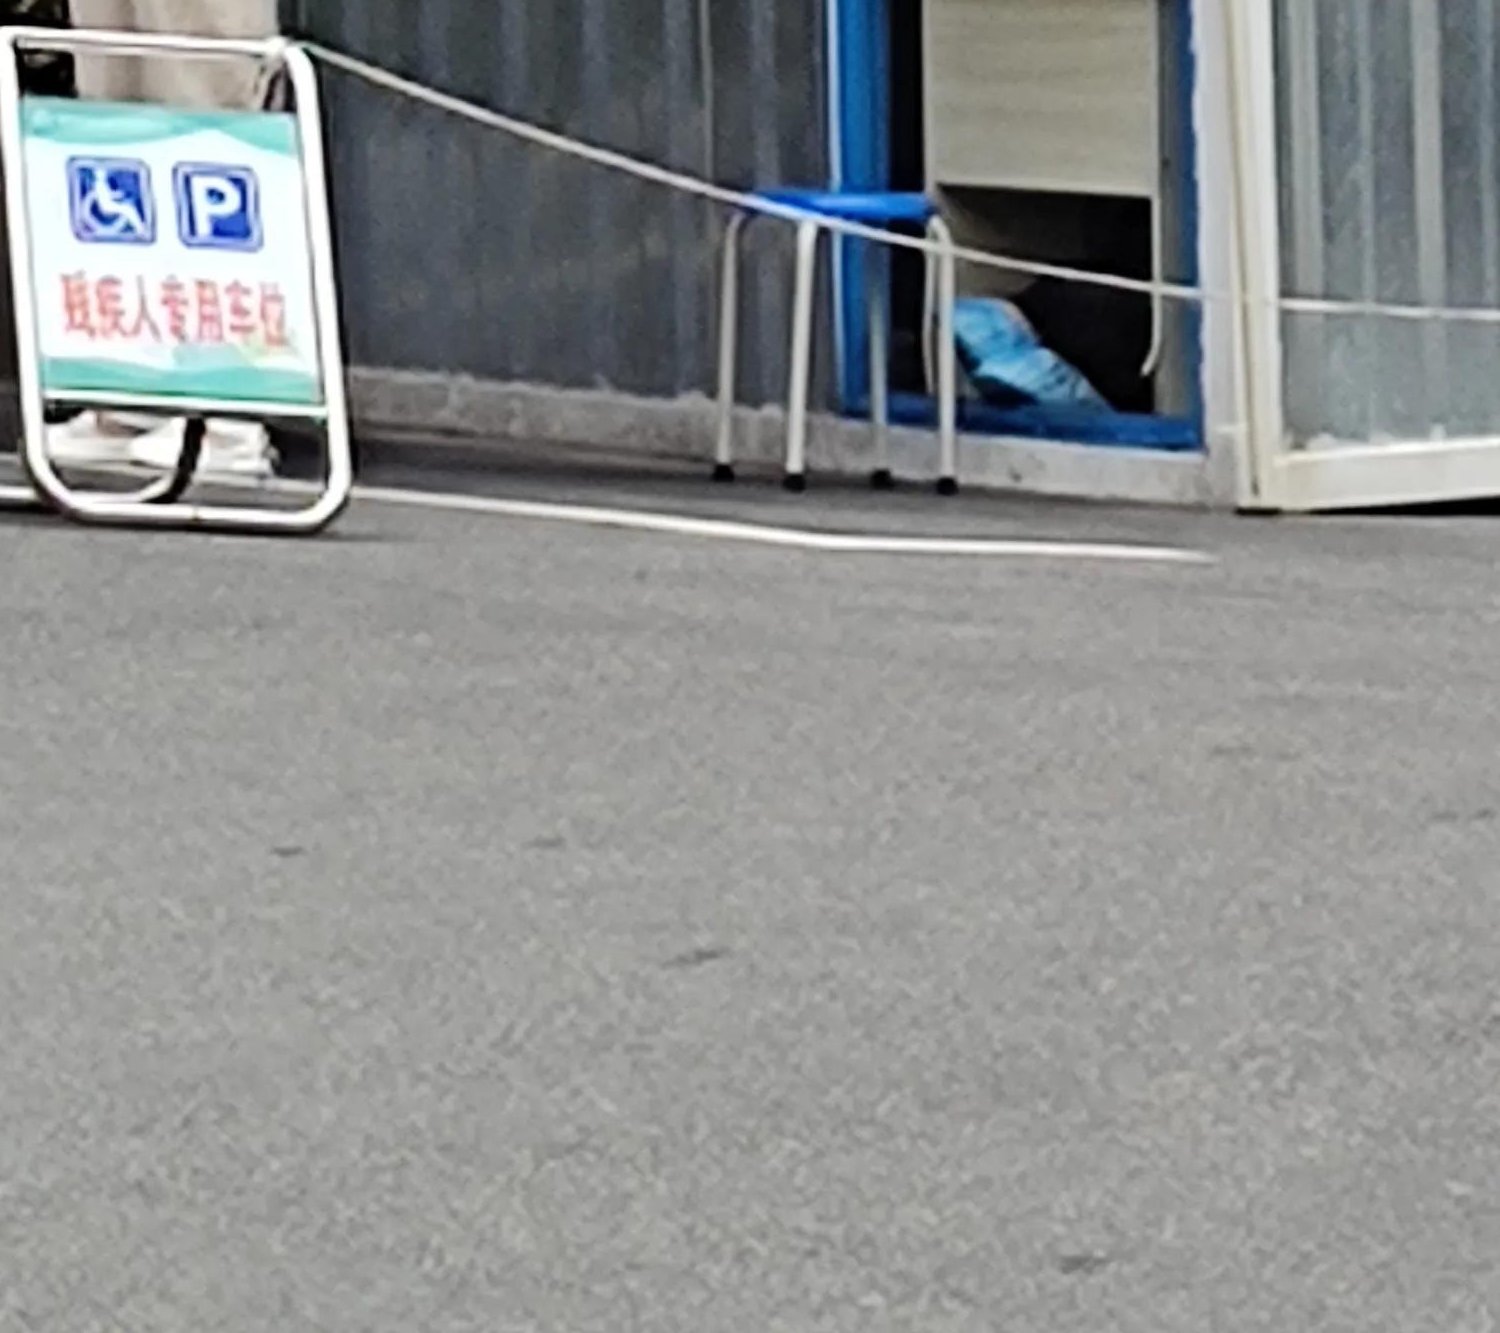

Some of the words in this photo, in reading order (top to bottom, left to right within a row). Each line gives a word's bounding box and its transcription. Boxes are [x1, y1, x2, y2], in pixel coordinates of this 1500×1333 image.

[189, 175, 241, 237] P
[60, 269, 292, 347] 残疾人专用车位
